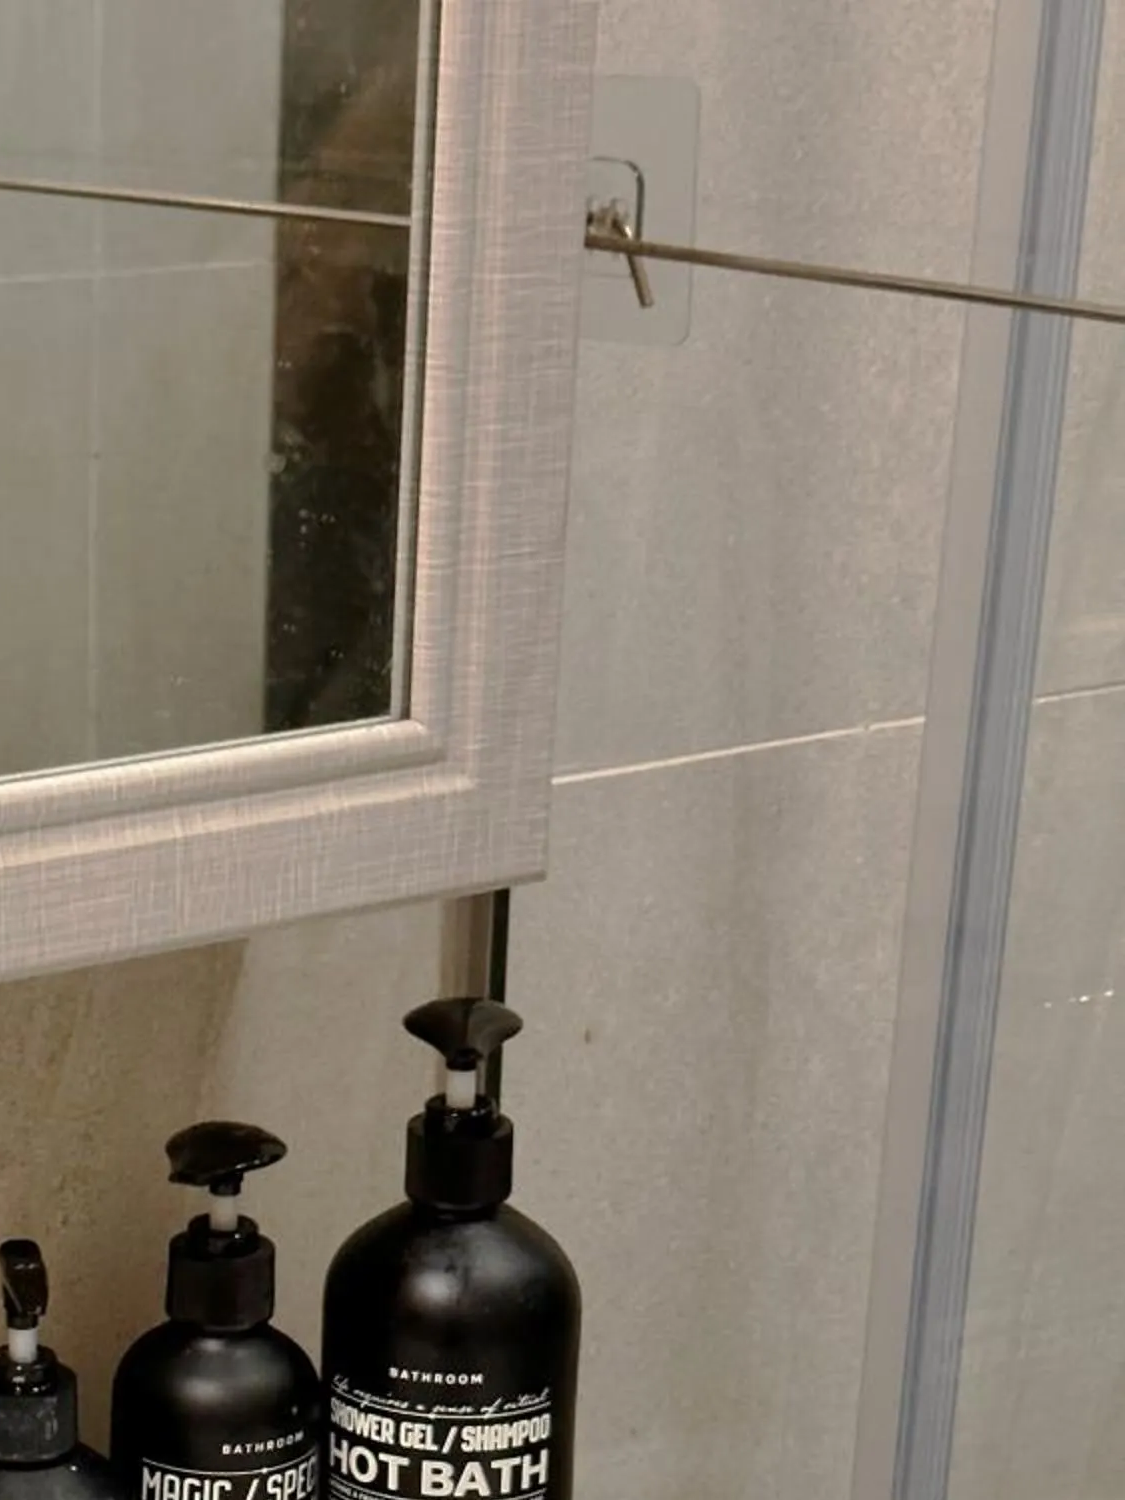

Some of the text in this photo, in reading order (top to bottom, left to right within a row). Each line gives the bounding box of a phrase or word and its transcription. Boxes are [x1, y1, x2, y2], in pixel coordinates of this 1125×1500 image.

[388, 1367, 484, 1385] BATHROOM
[222, 1430, 304, 1455] BATHROOM
[399, 1421, 438, 1451] GEL
[460, 1412, 552, 1452] SHAMPOO
[329, 1431, 549, 1497] HOT BATH
